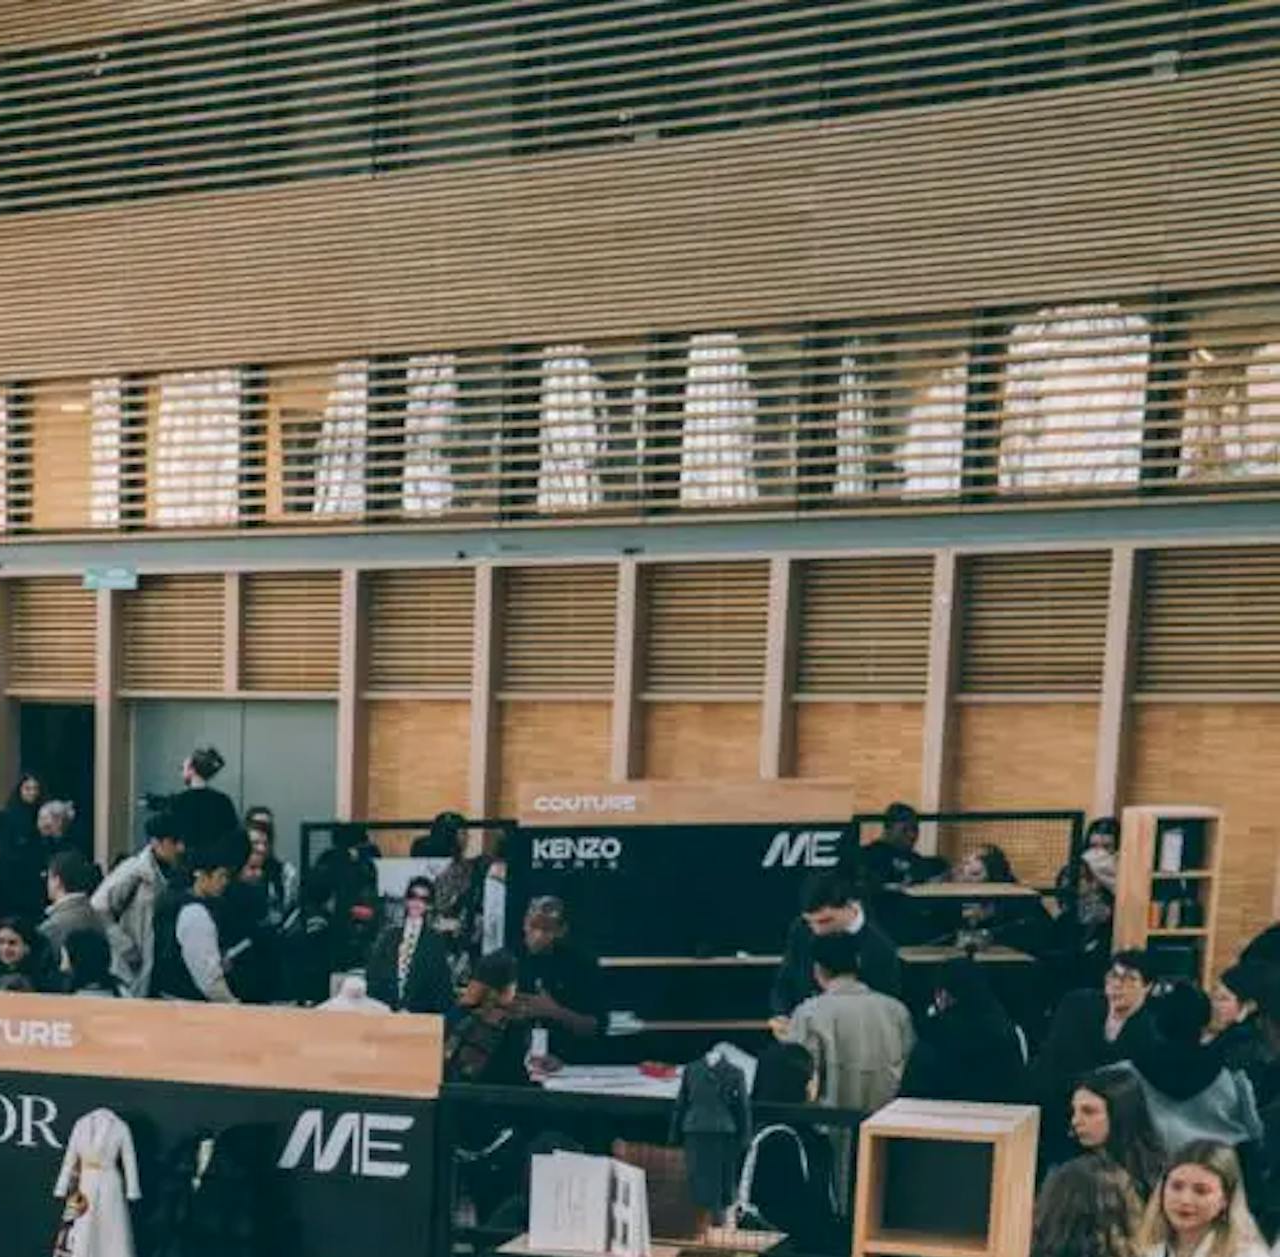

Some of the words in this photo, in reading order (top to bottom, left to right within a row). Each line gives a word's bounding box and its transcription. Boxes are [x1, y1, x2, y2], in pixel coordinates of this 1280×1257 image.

[533, 795, 635, 811] COUTURE
[532, 837, 621, 859] KENZO
[761, 832, 843, 868] ME
[277, 1108, 416, 1178] ME
